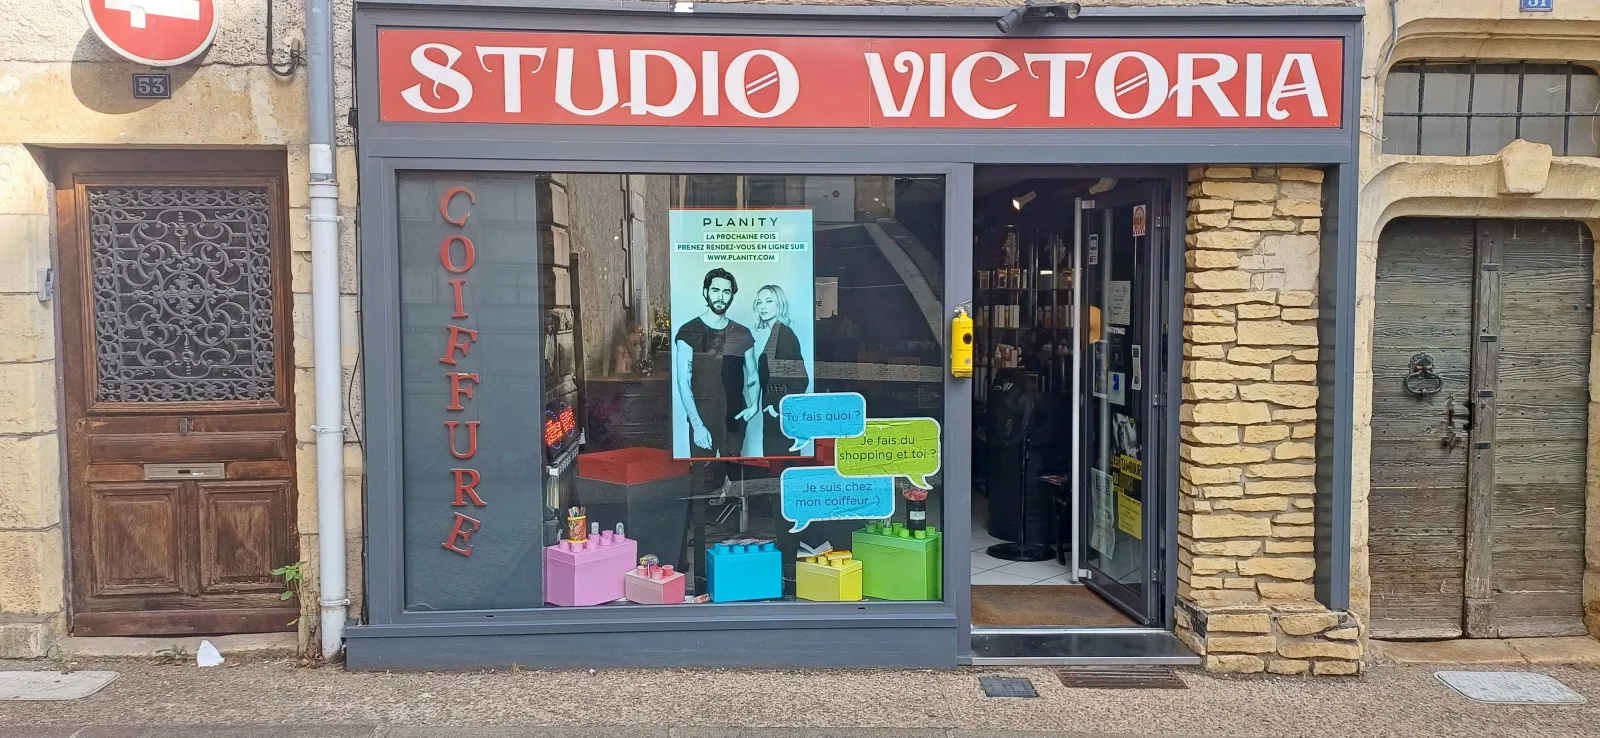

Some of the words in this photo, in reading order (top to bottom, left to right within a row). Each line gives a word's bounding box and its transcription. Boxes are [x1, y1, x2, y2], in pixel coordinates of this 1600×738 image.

[138, 77, 165, 94] 53
[400, 42, 800, 119] STUDIO
[864, 50, 1329, 119] VICTORIA
[703, 217, 778, 227] PLANITY
[439, 186, 488, 558] COIFFURE
[786, 412, 798, 421] Tu
[802, 412, 821, 421] fais
[825, 412, 851, 422] quoi
[855, 411, 860, 419] ?
[860, 436, 873, 446] Je
[877, 436, 896, 445] fais
[900, 435, 915, 444] du
[839, 450, 892, 461] shopping
[896, 451, 908, 459] et
[912, 450, 926, 459] toi
[930, 449, 936, 457] ?
[803, 484, 816, 493] Je
[820, 483, 842, 492] suis
[845, 482, 872, 492] chez
[795, 498, 821, 506] mon
[825, 496, 869, 506] coiffeur
